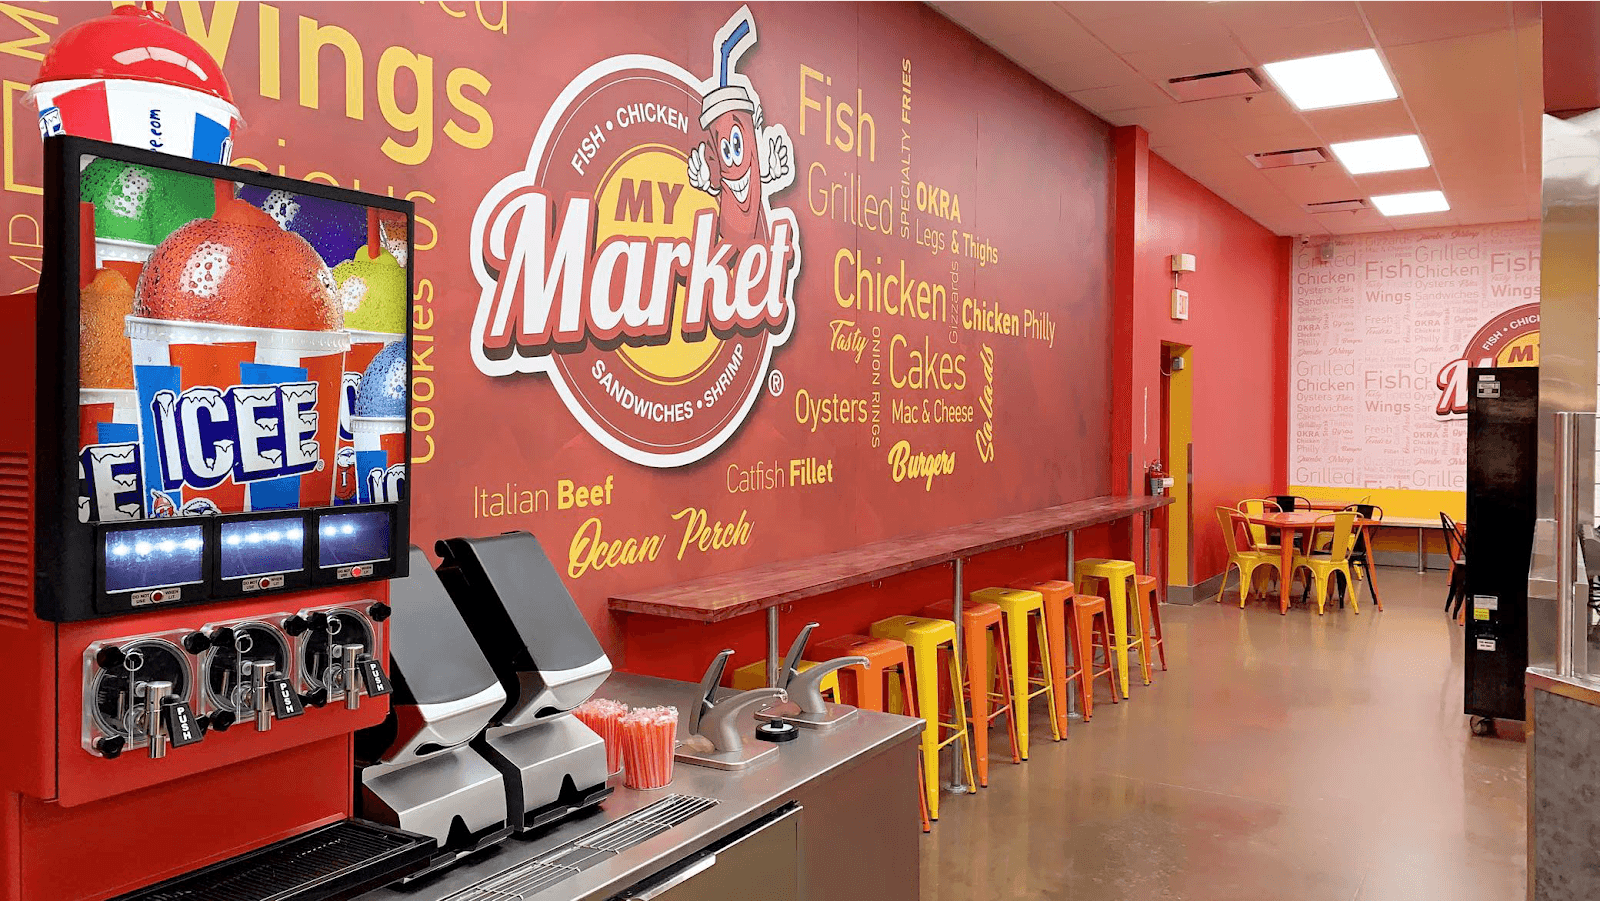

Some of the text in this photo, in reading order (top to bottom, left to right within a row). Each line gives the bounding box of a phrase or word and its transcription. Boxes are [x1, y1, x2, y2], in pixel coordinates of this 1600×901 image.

[799, 63, 876, 162] Fish
[570, 102, 689, 176] FISH CHICKEN
[901, 57, 913, 239] SPECIALTY FRIES
[614, 178, 685, 225] MY
[808, 161, 893, 235] Grilled
[916, 181, 961, 223] OKRA
[916, 218, 998, 267] Legs & Thighs
[1415, 242, 1480, 263] Grilled
[485, 190, 793, 340] Market
[1297, 271, 1356, 286] Chicken
[1365, 259, 1412, 280] Fish
[1415, 264, 1480, 279] Chicken
[834, 248, 946, 322] Chicken
[1298, 286, 1333, 297] Oysters
[1366, 290, 1411, 305] Wings
[1415, 290, 1480, 301] Sandwiches
[949, 261, 959, 344] Gizzards
[1298, 296, 1355, 308] Sandwiches
[962, 298, 1056, 348] Chicken Philly
[829, 319, 870, 364] Tasty
[1482, 330, 1503, 351] FISH
[1508, 344, 1540, 363] M
[889, 333, 966, 391] Cakes
[1297, 360, 1355, 377] Grilled
[591, 343, 745, 422] SANDWICHES SHRIMP
[871, 326, 881, 448] ONION RINGS
[1297, 378, 1355, 392] Chicken
[1365, 370, 1411, 389] Fish
[795, 389, 868, 432] Oysters
[892, 398, 974, 424] Mac & Cheese
[976, 343, 994, 463] Salads
[1297, 392, 1332, 402] Oysters
[1297, 403, 1355, 413] Sandwiches
[1365, 400, 1411, 415] Wings
[153, 384, 318, 490] ICEE
[1364, 424, 1393, 433] Fresh
[888, 440, 956, 492] Burgers
[1413, 446, 1440, 456] Philly
[727, 457, 833, 493] Catfish Fillet
[1297, 466, 1355, 484] Grilled
[1413, 469, 1465, 488] Grille
[474, 475, 614, 518] Italian Beef
[568, 507, 755, 579] Ocean Perch
[369, 663, 384, 691] PUSH
[280, 682, 294, 713] PUSH
[177, 706, 192, 740] PUSH
